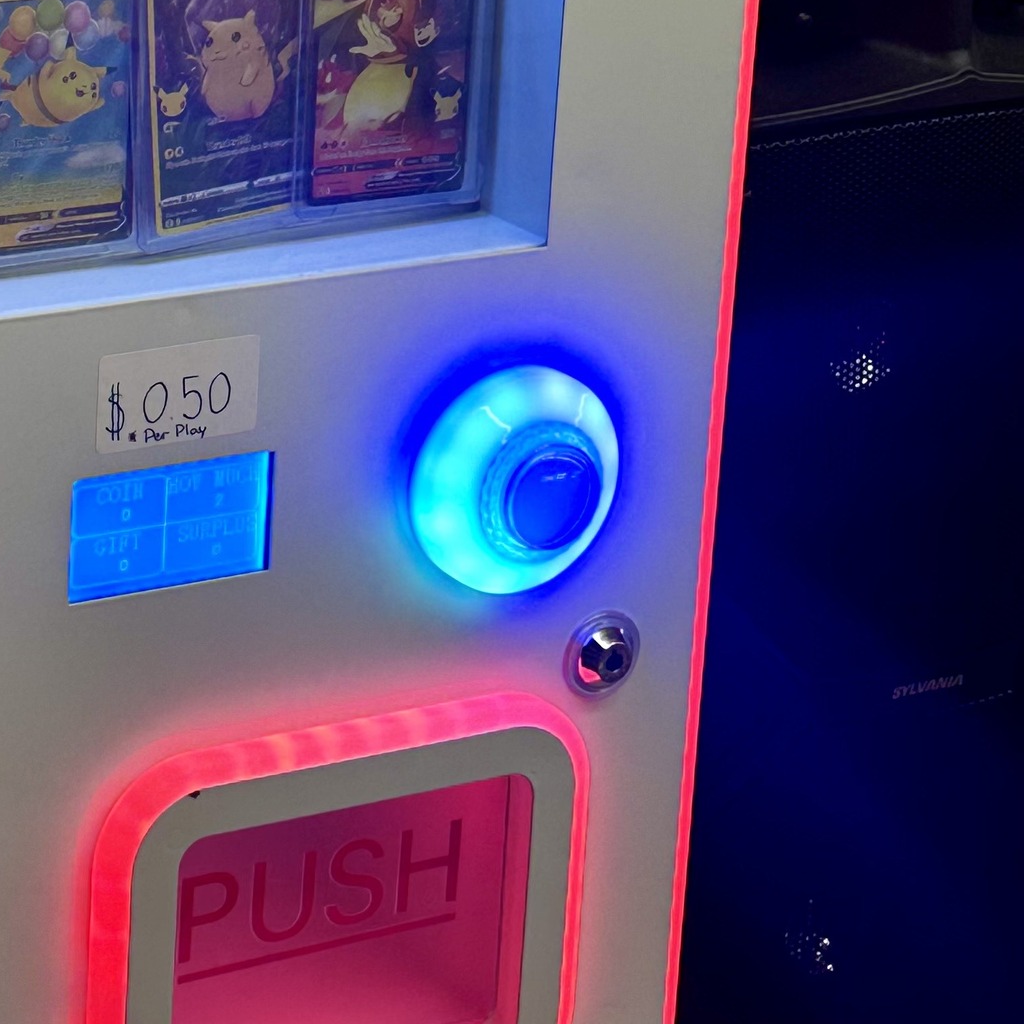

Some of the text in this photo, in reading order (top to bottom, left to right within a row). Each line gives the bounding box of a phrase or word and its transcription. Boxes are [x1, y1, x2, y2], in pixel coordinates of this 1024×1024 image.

[143, 423, 207, 444] Per Play
[891, 674, 964, 700] SYLVANIA
[177, 818, 463, 964] PUSH
